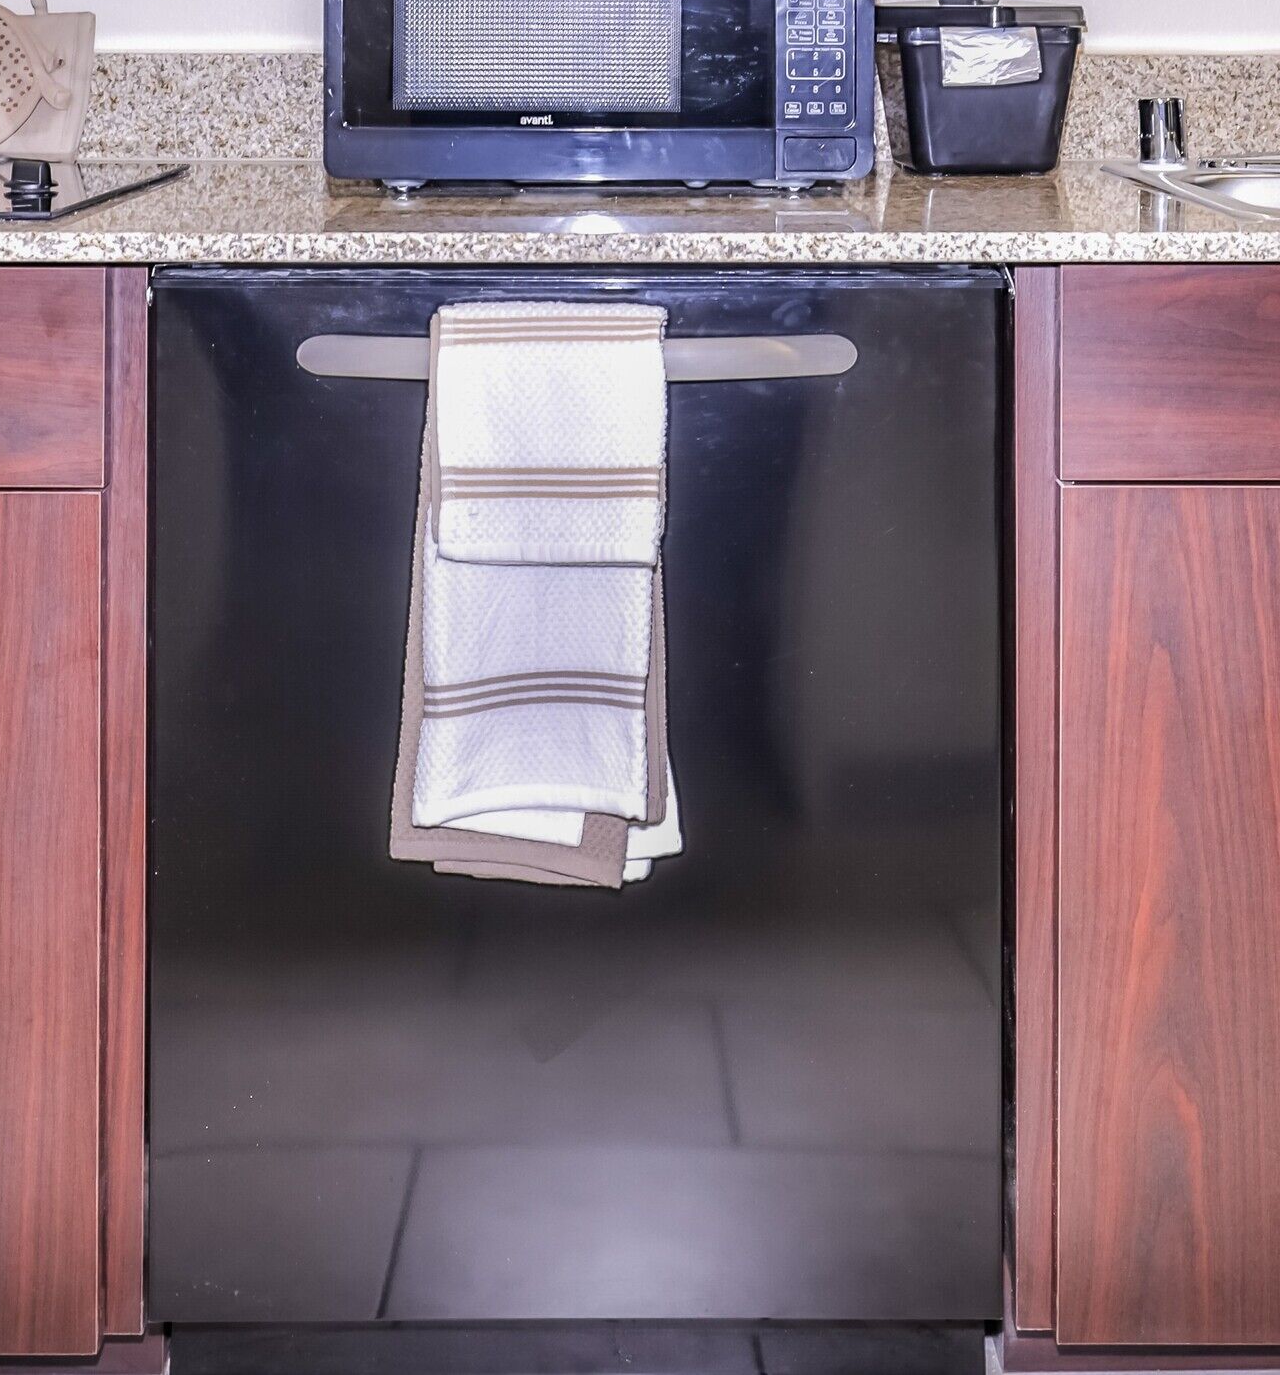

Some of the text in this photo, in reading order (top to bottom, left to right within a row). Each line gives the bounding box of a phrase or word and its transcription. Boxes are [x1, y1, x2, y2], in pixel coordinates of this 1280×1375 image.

[791, 52, 795, 60] 1
[813, 52, 818, 60] 2
[836, 52, 841, 60] 3
[791, 68, 795, 76] 4
[813, 68, 818, 76] 5
[836, 68, 841, 76] 6
[791, 85, 795, 93] 7
[813, 85, 818, 93] 8
[836, 85, 841, 93] 9
